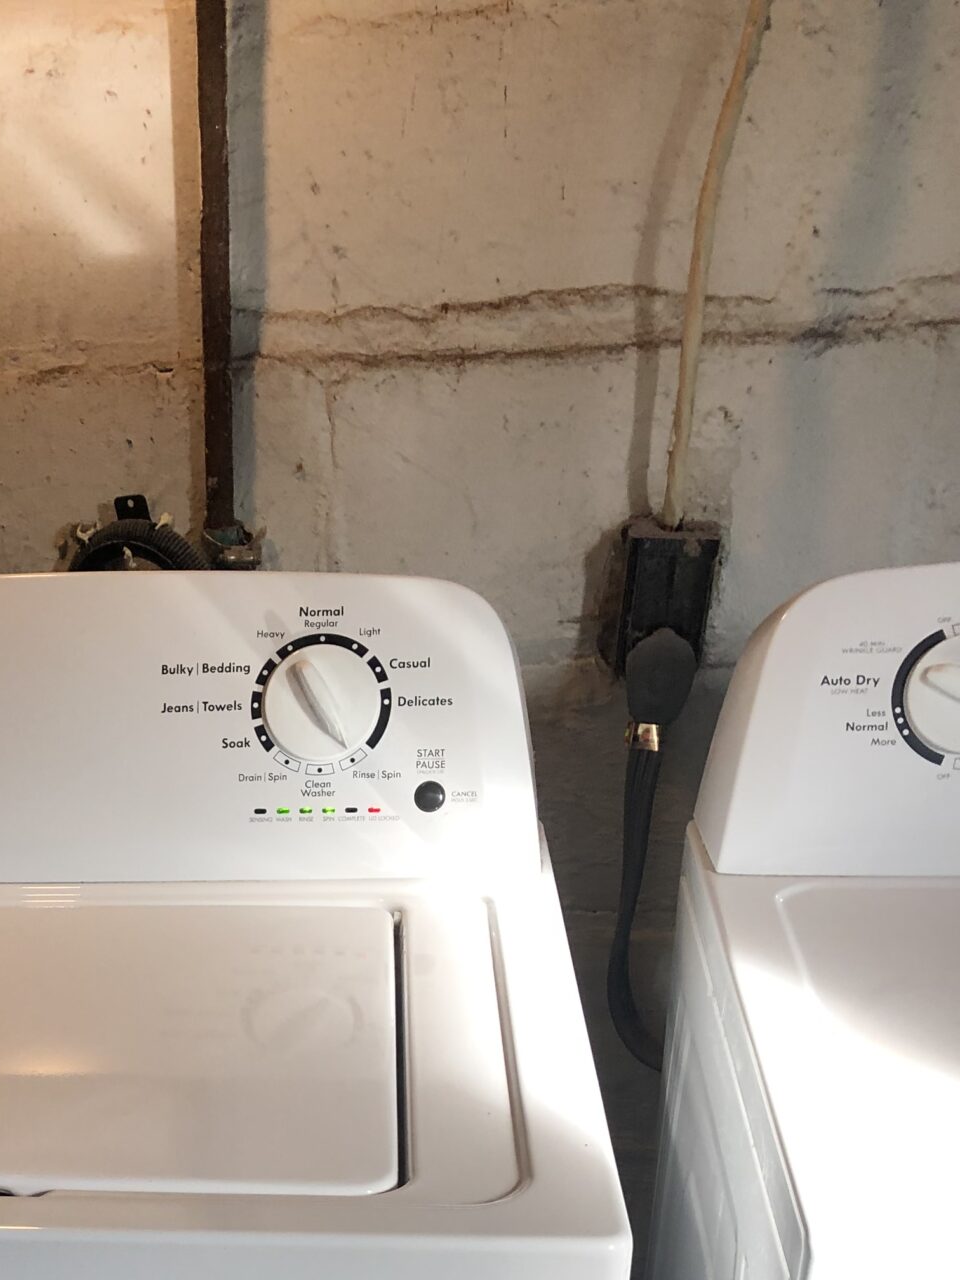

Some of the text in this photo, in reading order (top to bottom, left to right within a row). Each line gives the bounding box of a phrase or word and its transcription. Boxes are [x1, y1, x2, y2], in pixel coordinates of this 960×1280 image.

[299, 606, 344, 617] Normal
[304, 619, 338, 629] Regular
[256, 630, 286, 639] Heavy
[359, 628, 381, 637] Light
[389, 657, 431, 669] Casual
[161, 662, 251, 676] Bulky Bedding
[820, 674, 880, 687] Auto Dry
[161, 700, 242, 713] Jeans Towels
[397, 696, 453, 707] Delicates
[866, 708, 886, 717] Less
[846, 721, 889, 732] Normal
[221, 737, 251, 749] Soak
[870, 737, 897, 746] More
[416, 748, 445, 758] START
[415, 760, 446, 769] PAUSE
[238, 772, 288, 783] Drain Spin
[352, 770, 402, 780] Rinse Spin
[304, 780, 332, 789] Clean
[300, 788, 336, 797] Washer
